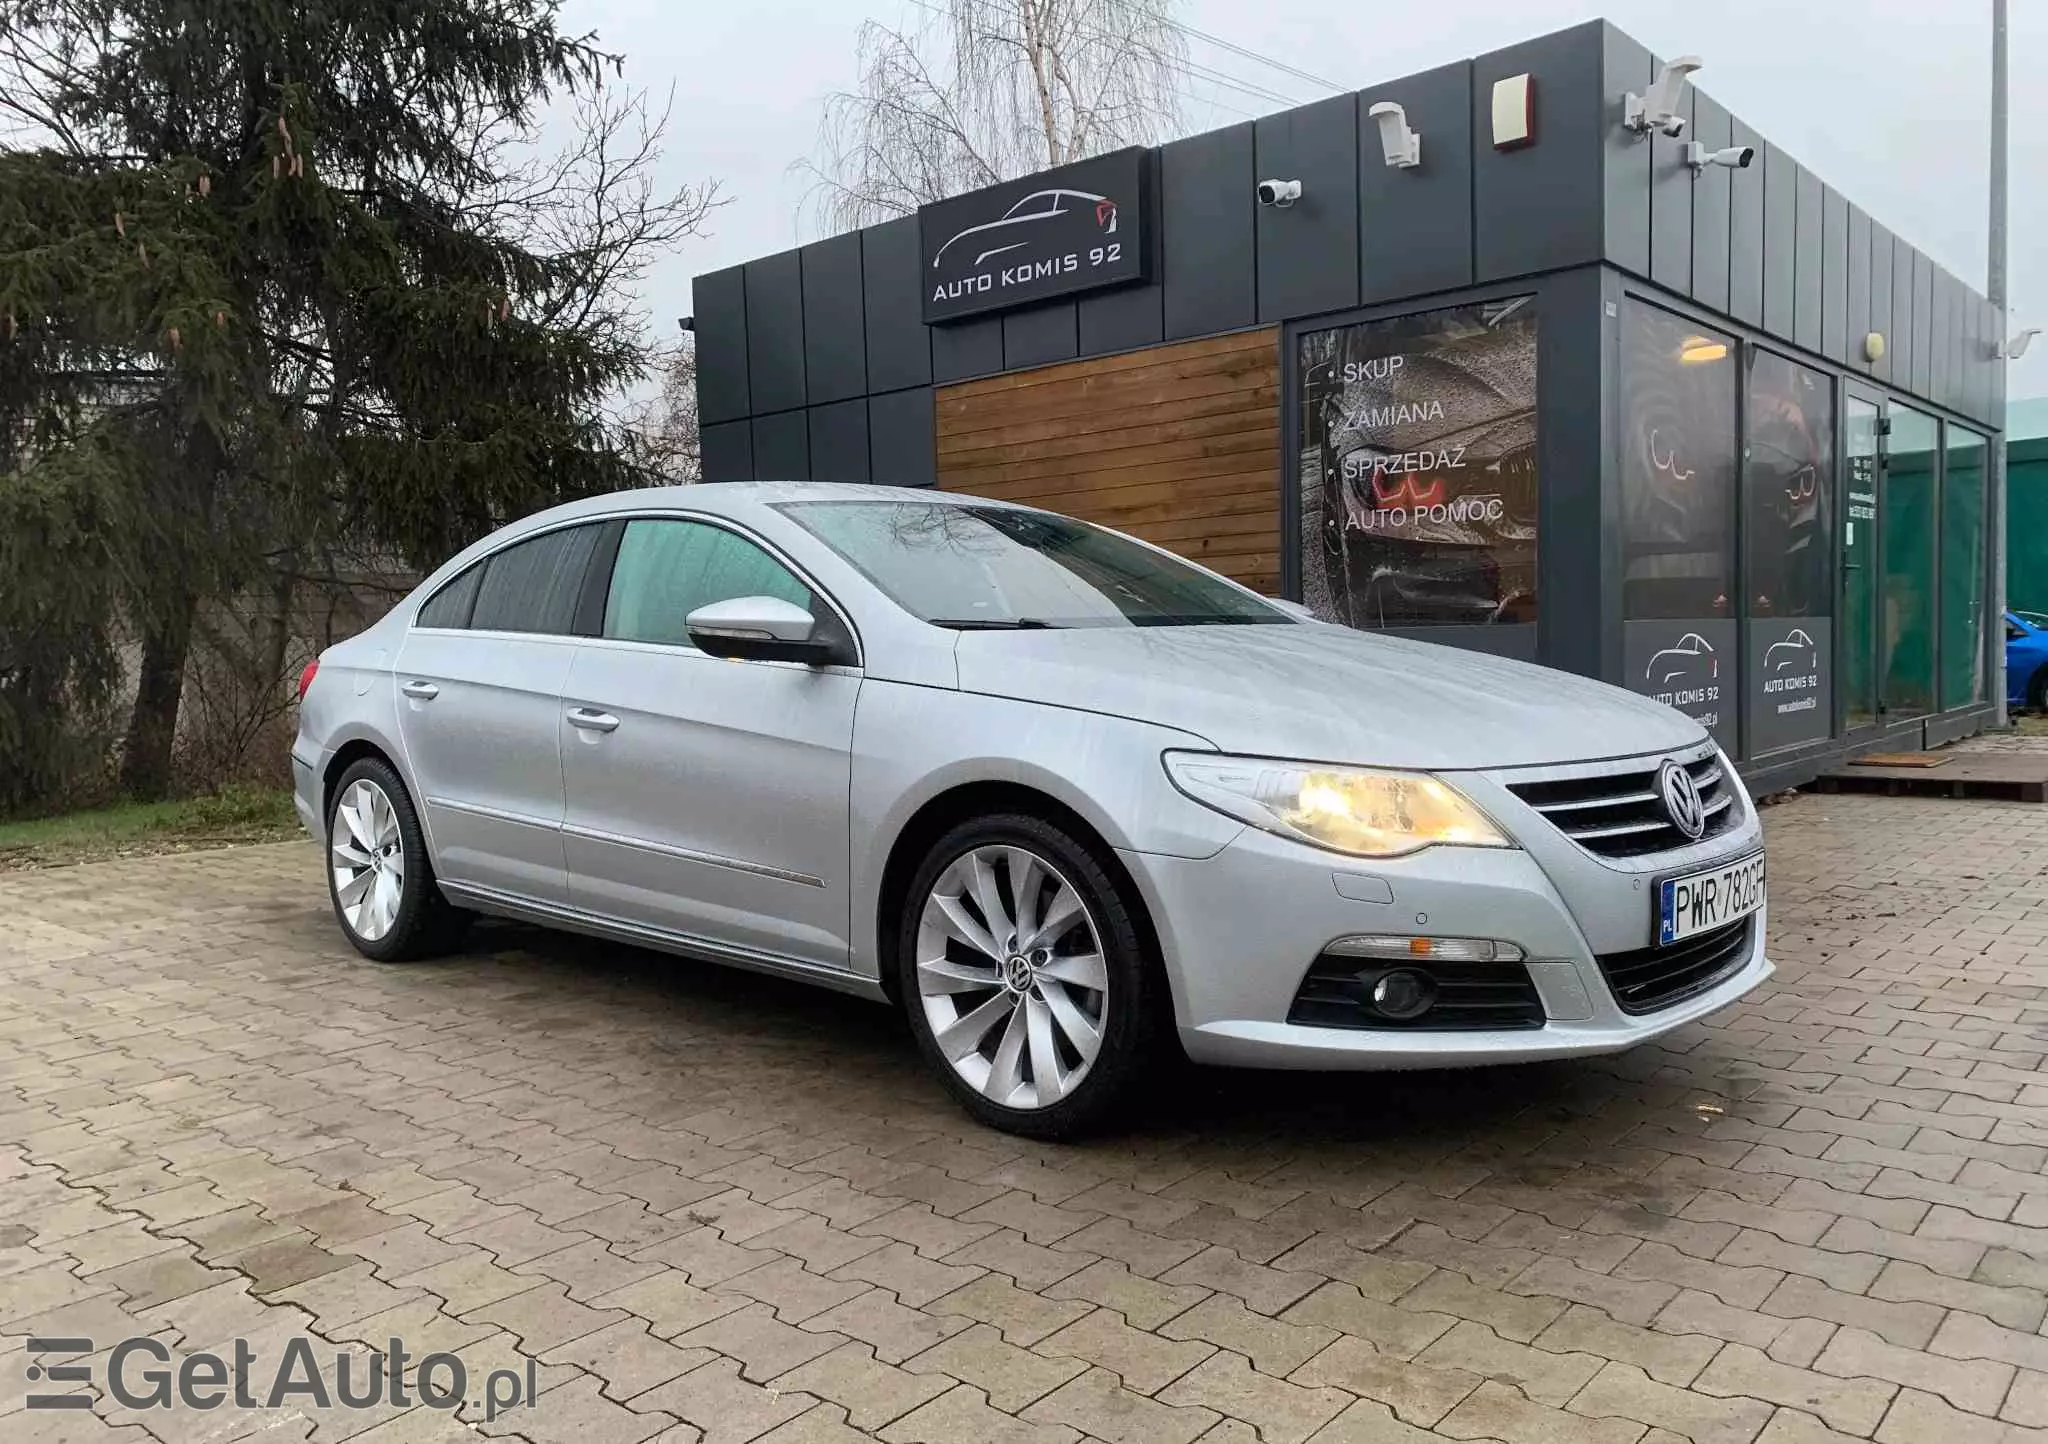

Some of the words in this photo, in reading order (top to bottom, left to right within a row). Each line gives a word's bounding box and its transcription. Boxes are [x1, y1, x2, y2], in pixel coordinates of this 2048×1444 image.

[933, 273, 992, 302] AUTO
[1001, 254, 1078, 287] KOMIS
[1089, 243, 1122, 267] 92
[1343, 355, 1404, 382] SKUP
[1343, 400, 1445, 431] ZAMIANA
[1345, 507, 1407, 531] AUTO
[1414, 498, 1504, 525] POMOC
[1675, 688, 1705, 705] KOMIS
[1707, 686, 1719, 701] 92
[1763, 679, 1784, 694] AUTO
[1676, 878, 1717, 933] PWR
[1663, 919, 1673, 933] PL
